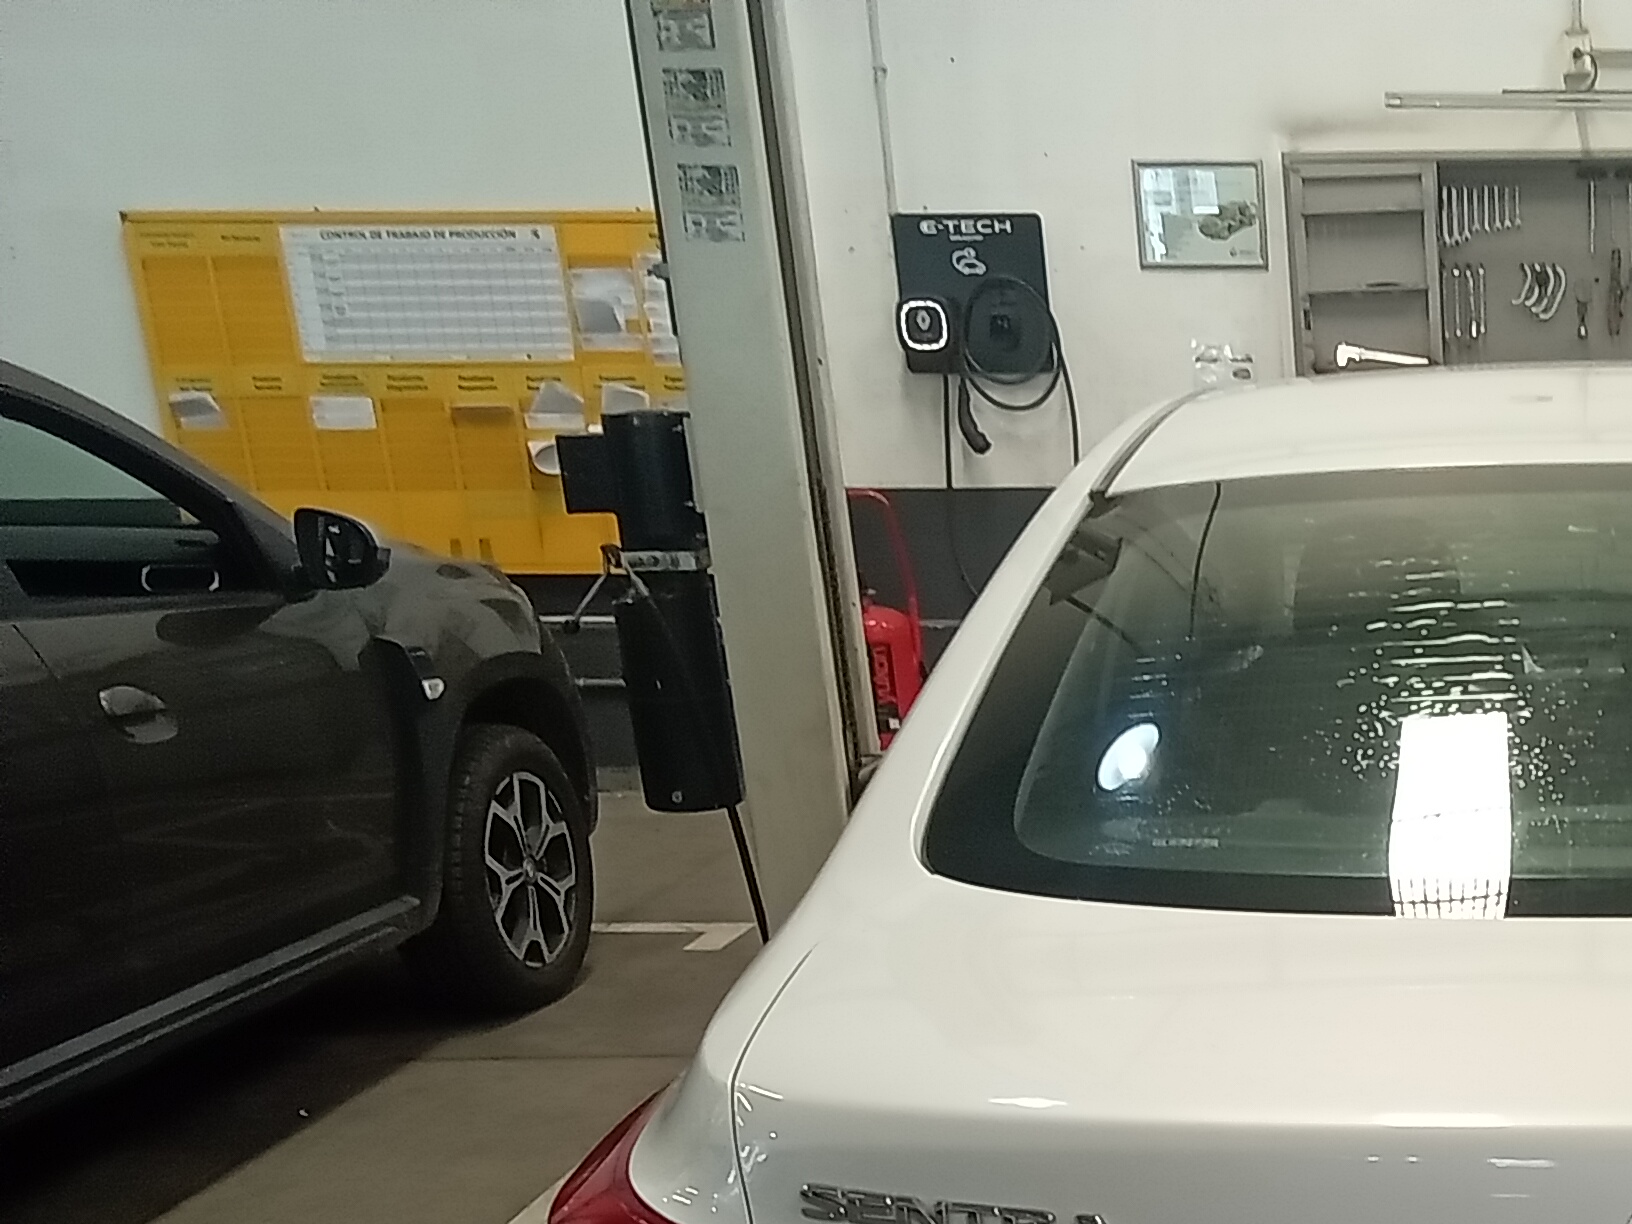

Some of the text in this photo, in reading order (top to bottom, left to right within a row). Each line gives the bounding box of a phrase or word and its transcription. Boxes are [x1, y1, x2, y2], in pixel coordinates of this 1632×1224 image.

[320, 229, 368, 240] CONTROL
[369, 230, 383, 240] DE
[386, 229, 432, 240] TRABAJO
[433, 229, 446, 239] DE
